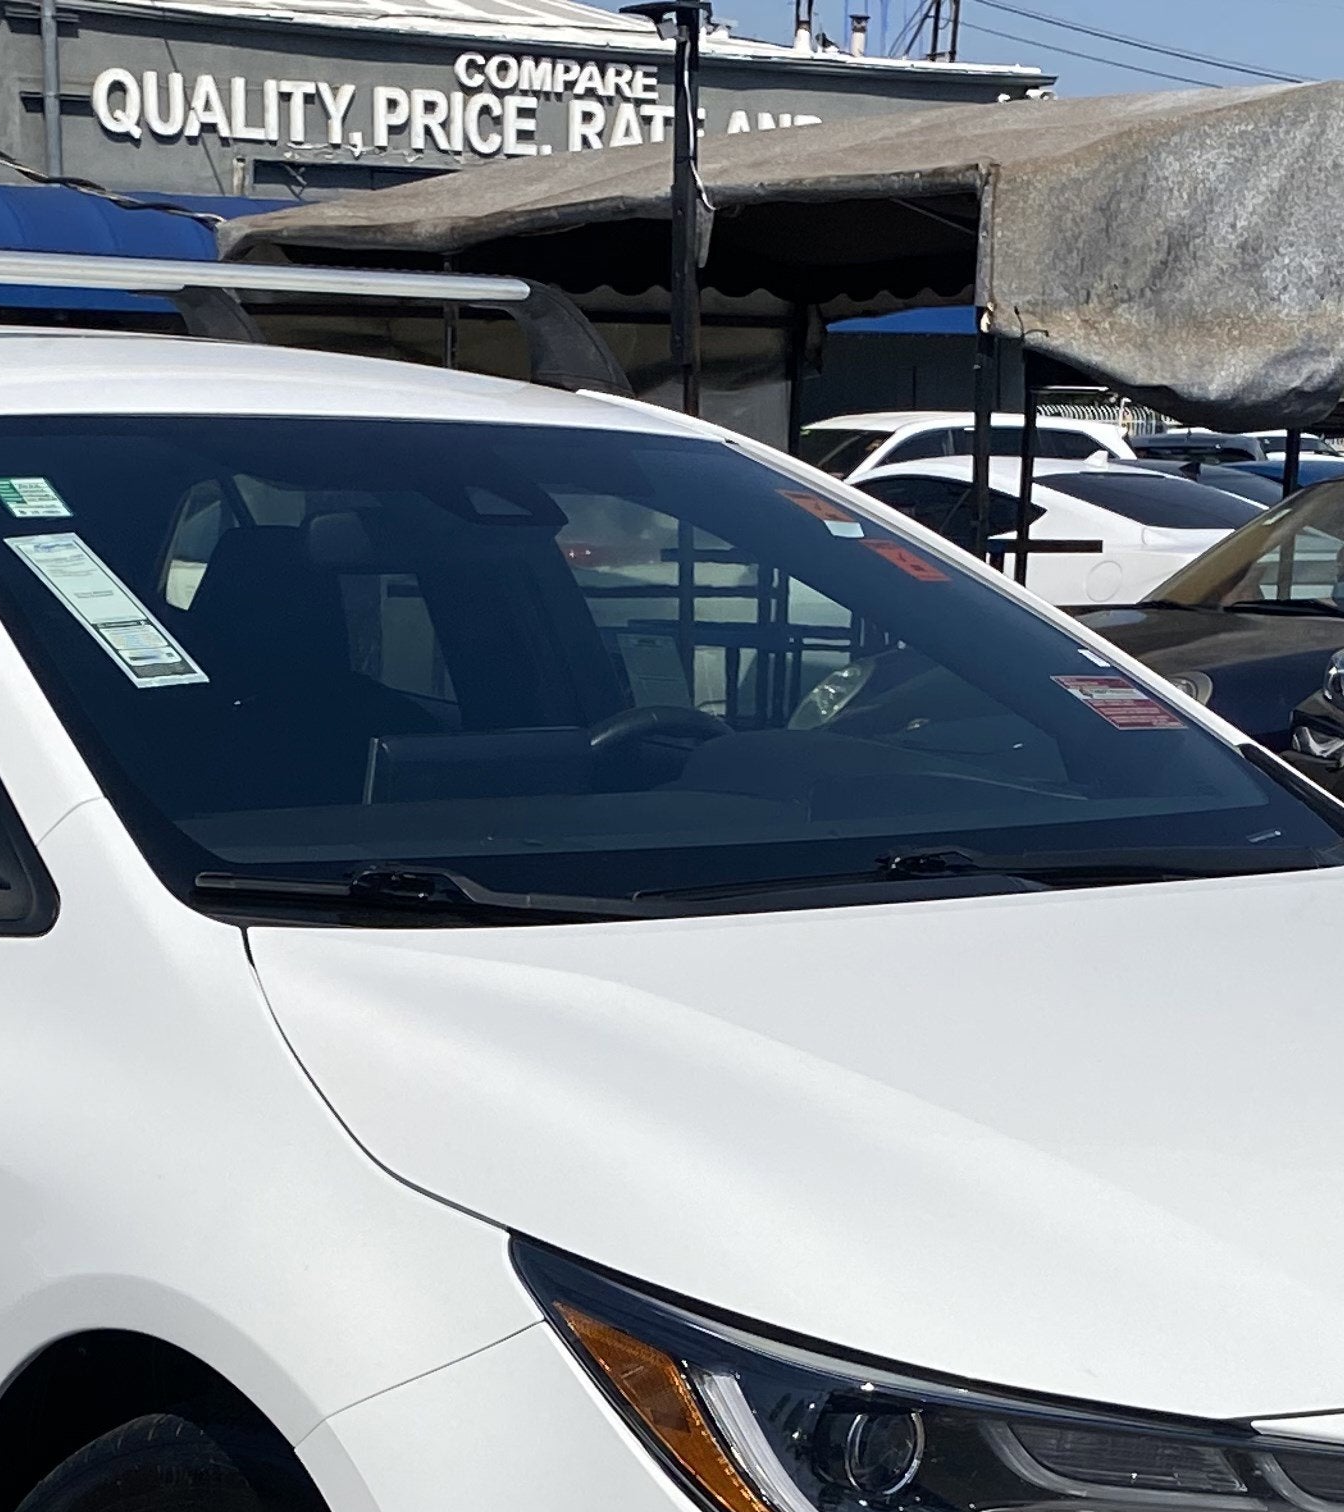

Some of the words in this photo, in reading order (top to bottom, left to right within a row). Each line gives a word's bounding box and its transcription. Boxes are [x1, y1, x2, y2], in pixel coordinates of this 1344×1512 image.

[454, 52, 659, 101] COMPARE
[92, 67, 364, 157] QUALITY,
[568, 99, 705, 152] RAT
